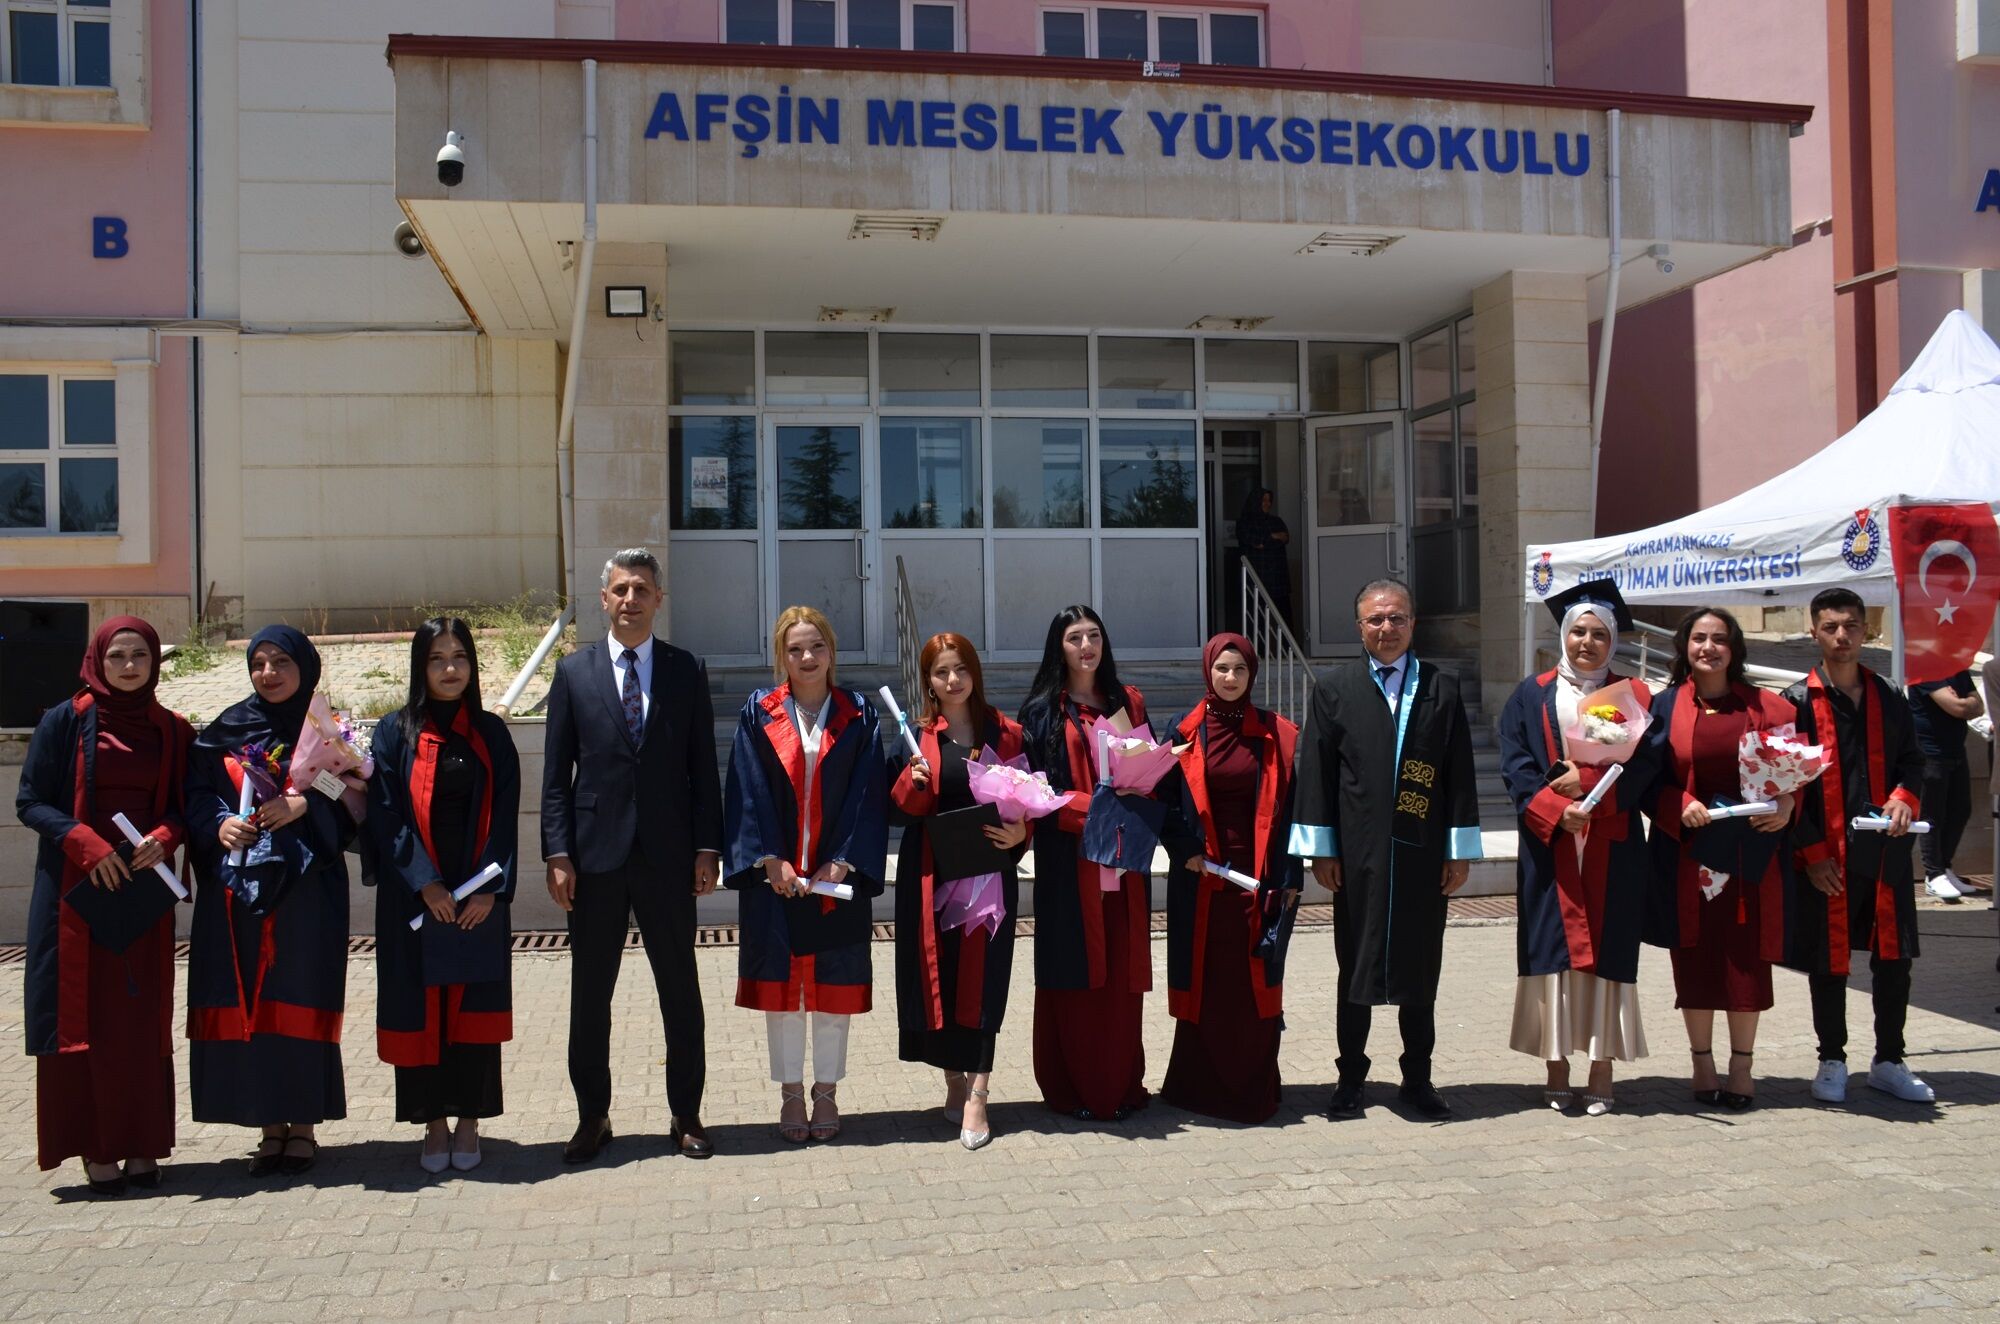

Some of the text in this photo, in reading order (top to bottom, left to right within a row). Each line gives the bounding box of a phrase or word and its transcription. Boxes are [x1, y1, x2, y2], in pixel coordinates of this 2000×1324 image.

[646, 86, 1590, 177] AFŞİN MESLEK YÜKSEKOKULU
[1974, 168, 2000, 213] A
[92, 216, 129, 259] B
[1624, 533, 1735, 557] KAHRAMANMARAŞ
[1627, 562, 1668, 590] İMAM
[1673, 544, 1801, 587] ÜNİVERSİTESİ
